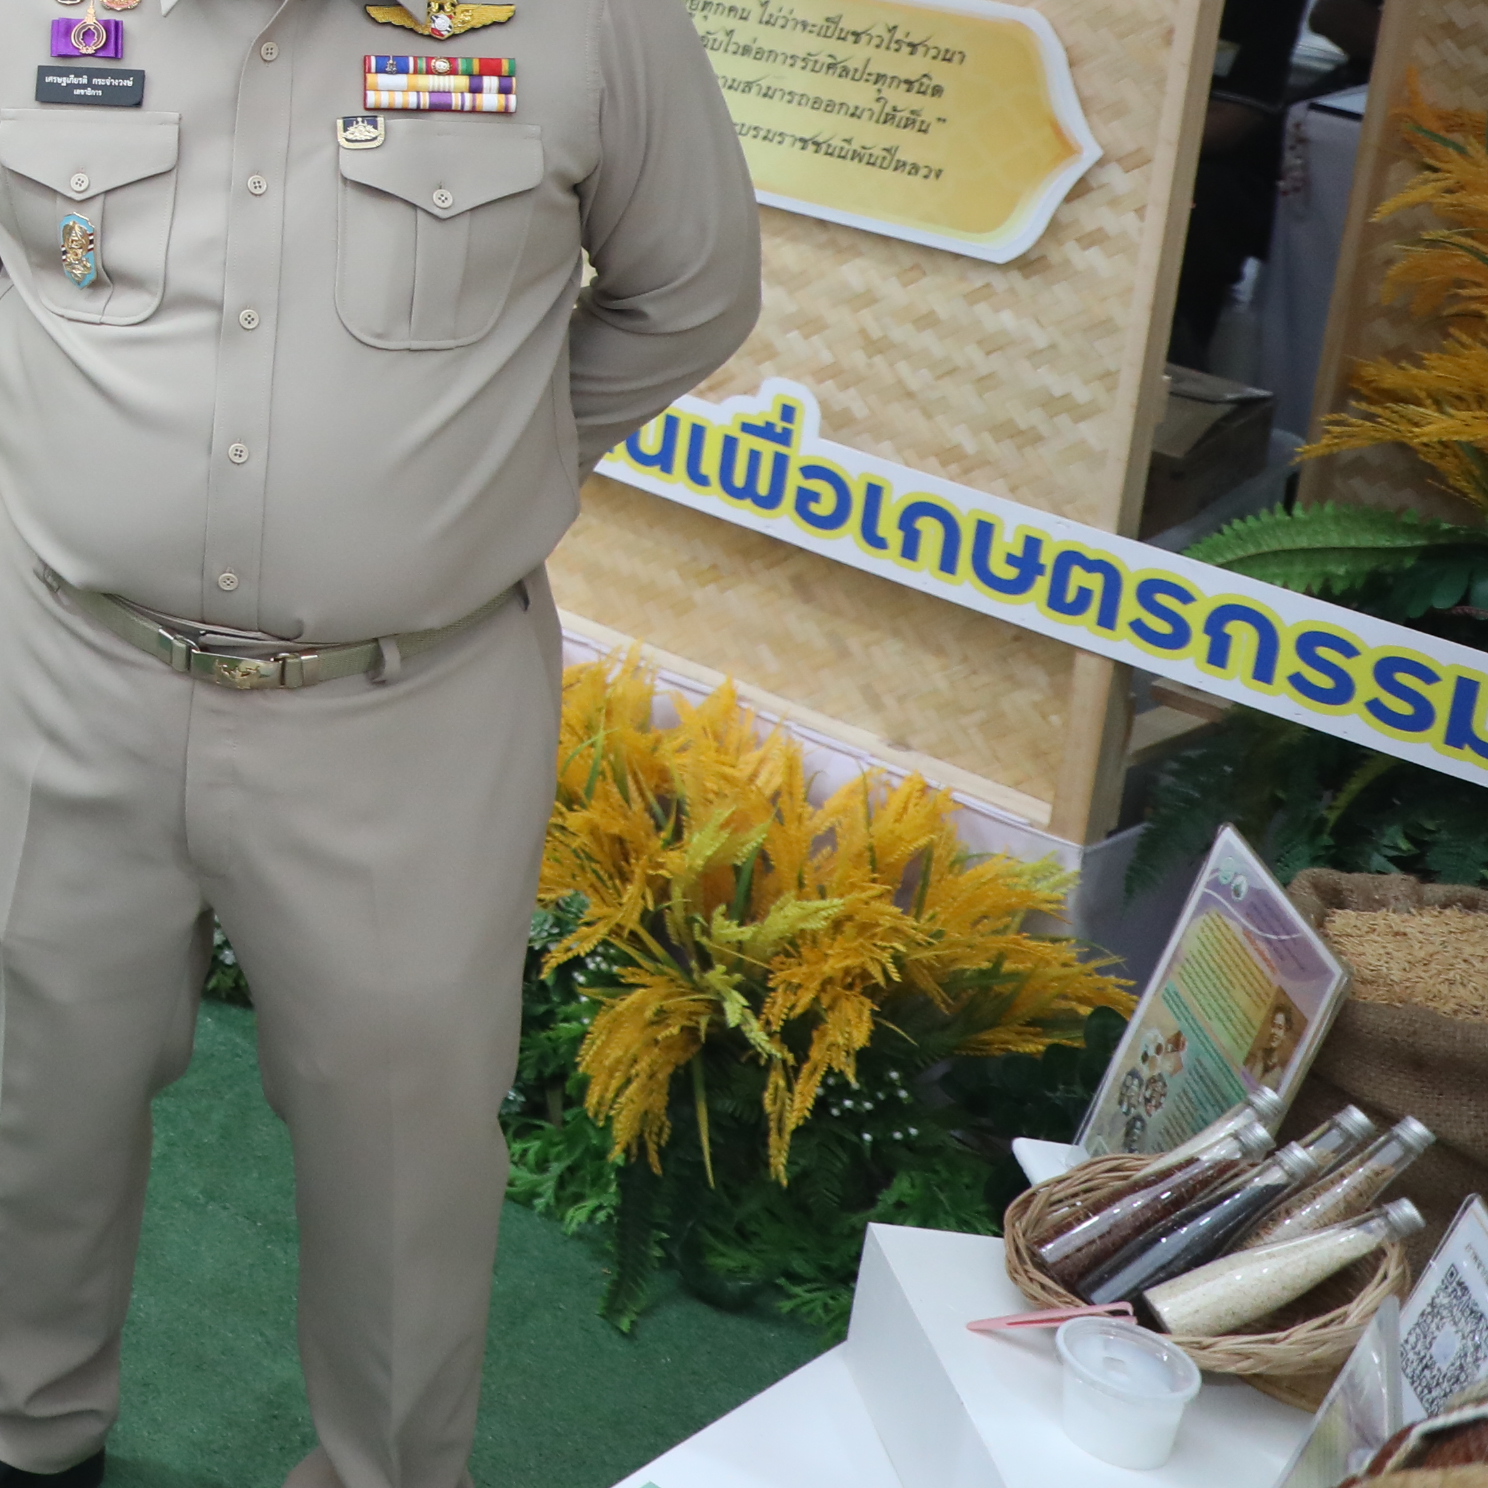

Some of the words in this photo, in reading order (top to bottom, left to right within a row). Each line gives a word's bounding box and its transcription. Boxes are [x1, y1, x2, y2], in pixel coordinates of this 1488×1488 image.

[757, 1, 966, 66] ไม่ว่าจะเป็นชาวไร่ชาวนา
[45, 75, 88, 86] เศรษฐเกียรติ
[74, 88, 102, 96] เลขาธิการ
[587, 400, 1488, 760] นเพื่อเกษตรกรร
